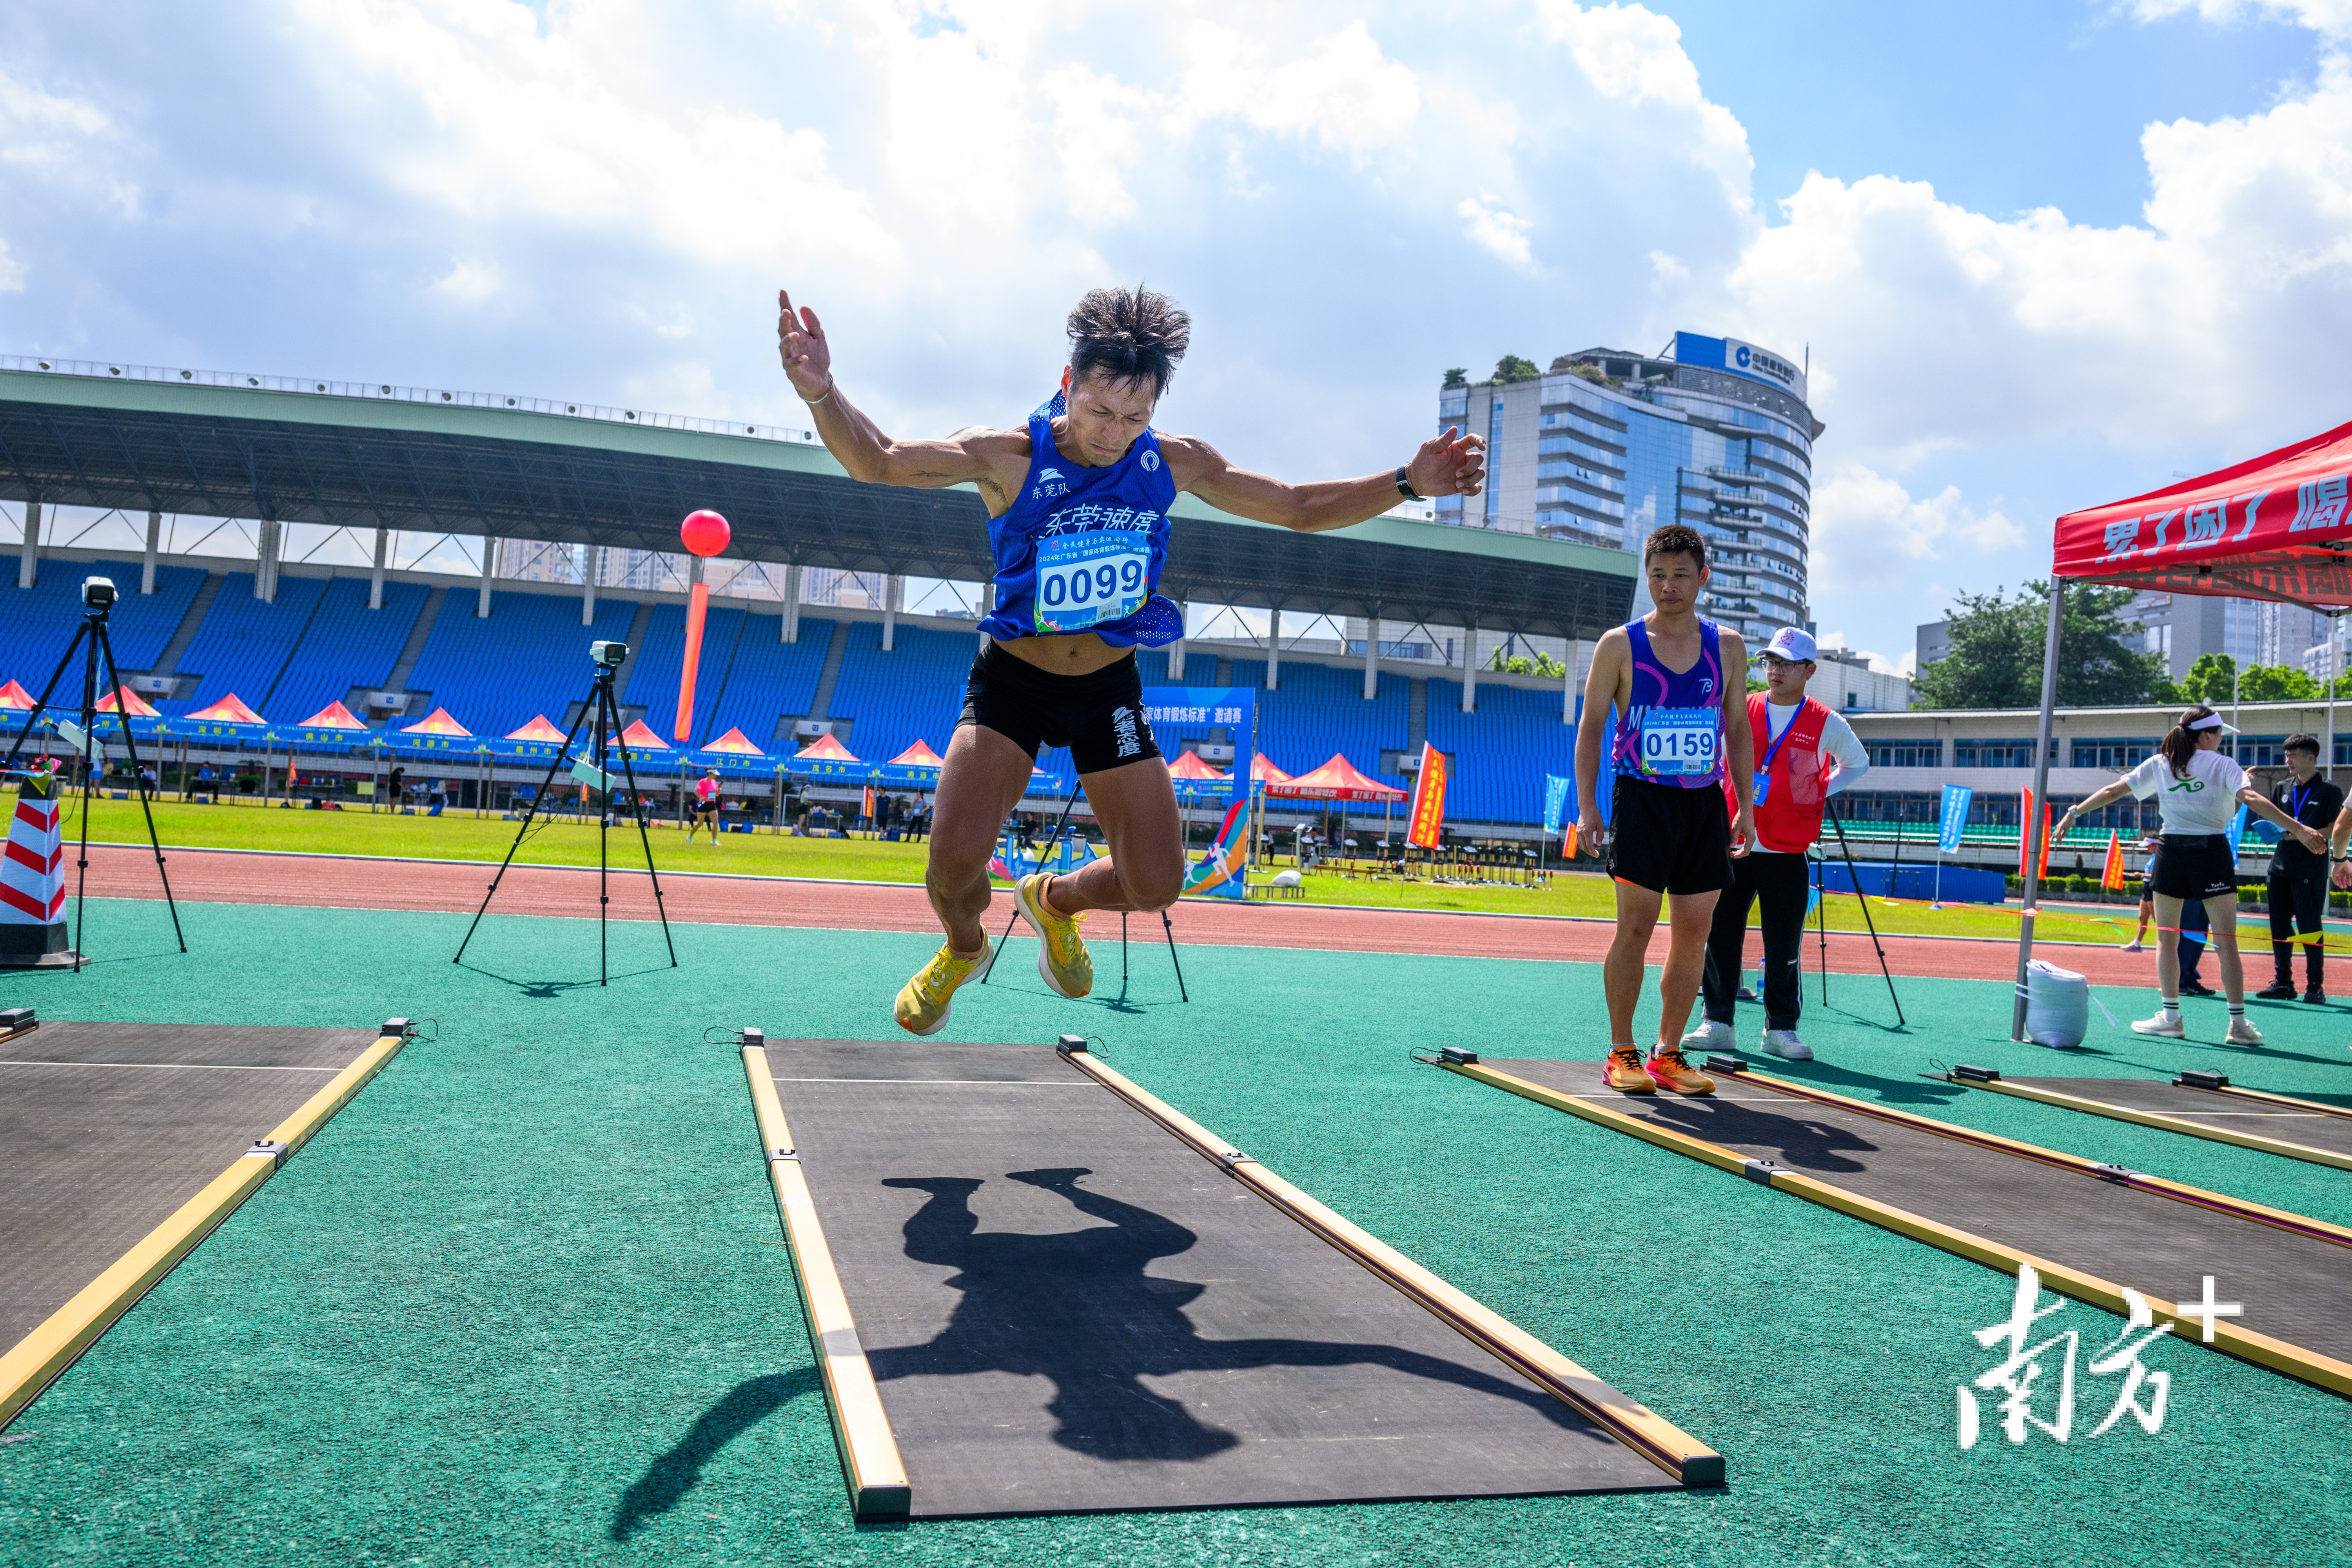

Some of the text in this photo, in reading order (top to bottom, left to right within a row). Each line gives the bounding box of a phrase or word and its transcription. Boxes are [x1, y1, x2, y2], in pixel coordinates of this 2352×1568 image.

[1032, 483, 1071, 499] 东莞队
[2095, 474, 2352, 563] 累了困了 喝
[1062, 536, 1129, 549] 全民健身与奥运同行
[1039, 552, 1078, 562] 2024年广东省
[1044, 560, 1143, 606] 0099
[1214, 707, 1242, 723] 邀请赛
[1646, 733, 1713, 757] 0159
[716, 758, 750, 767] 江门市
[813, 764, 846, 773] 茂名市
